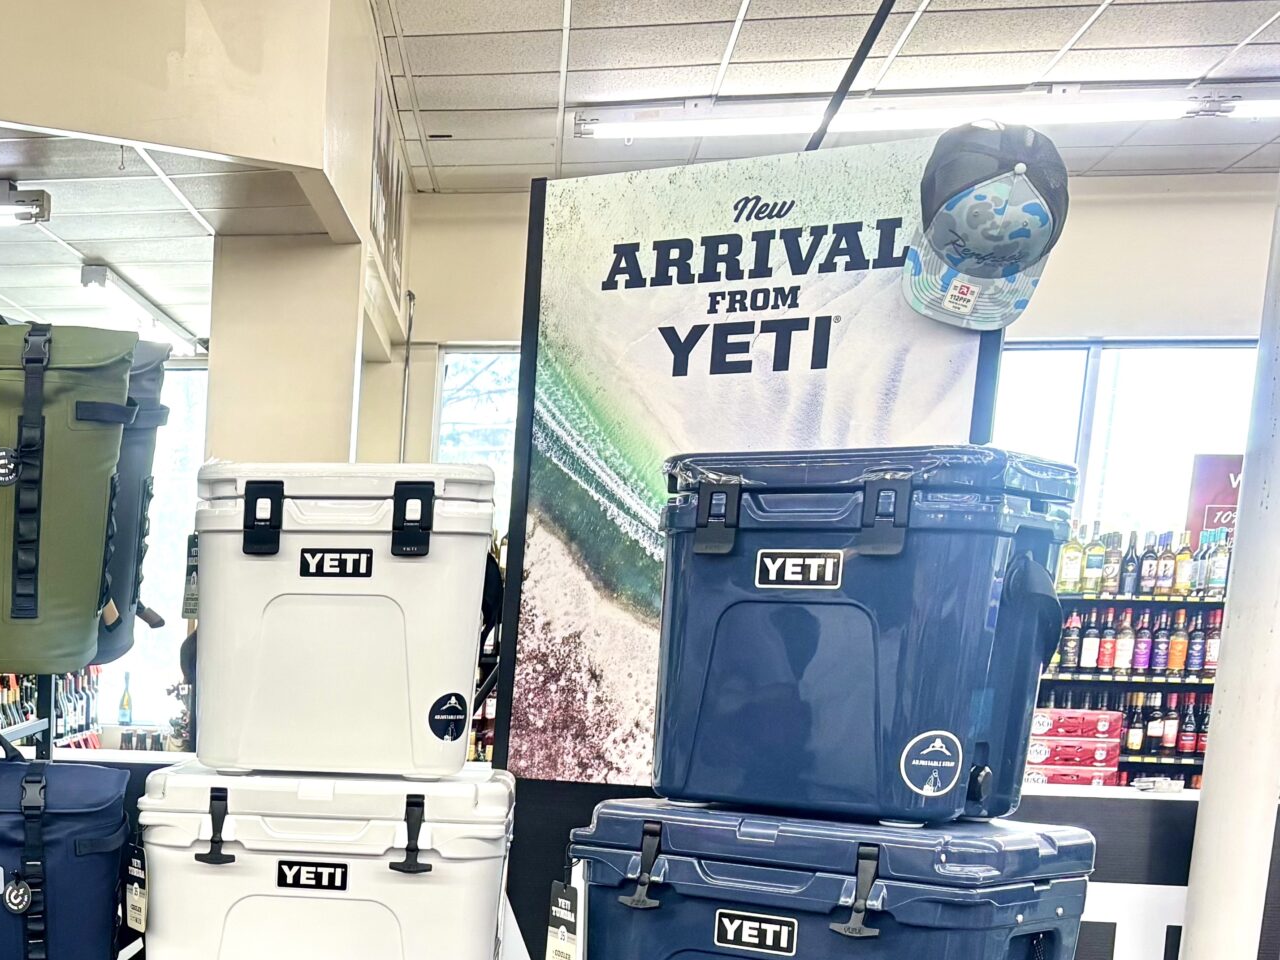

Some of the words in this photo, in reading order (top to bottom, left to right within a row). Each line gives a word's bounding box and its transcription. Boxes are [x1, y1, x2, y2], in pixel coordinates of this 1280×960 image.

[733, 197, 795, 223] New
[601, 217, 910, 290] ARRIVAL
[707, 286, 800, 314] FROM
[303, 553, 369, 574] YETI
[763, 557, 834, 581] YETI
[281, 865, 341, 886] YETI
[721, 917, 789, 948] YETI
